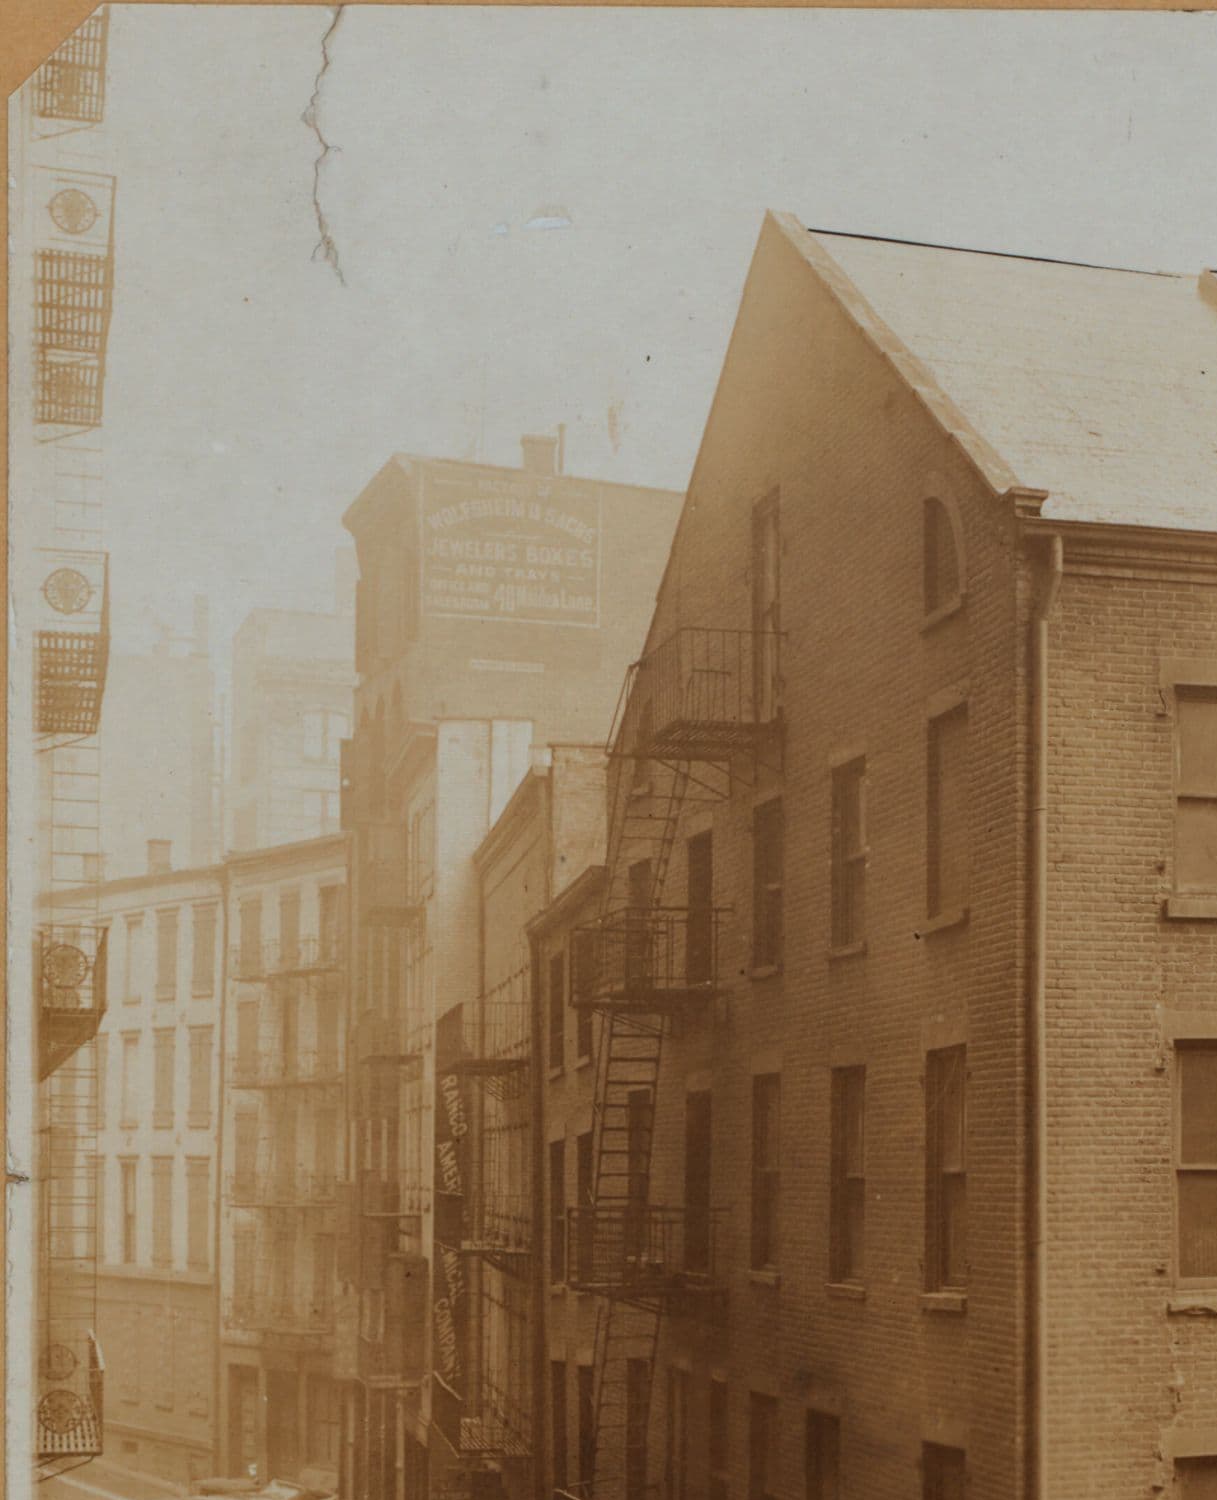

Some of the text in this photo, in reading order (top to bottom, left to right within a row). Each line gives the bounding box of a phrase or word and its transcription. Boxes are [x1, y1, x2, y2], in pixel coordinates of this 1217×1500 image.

[426, 537, 594, 569] JEWELERS BOXES
[455, 563, 561, 583] AND TRAYS
[560, 587, 593, 611] Lane
